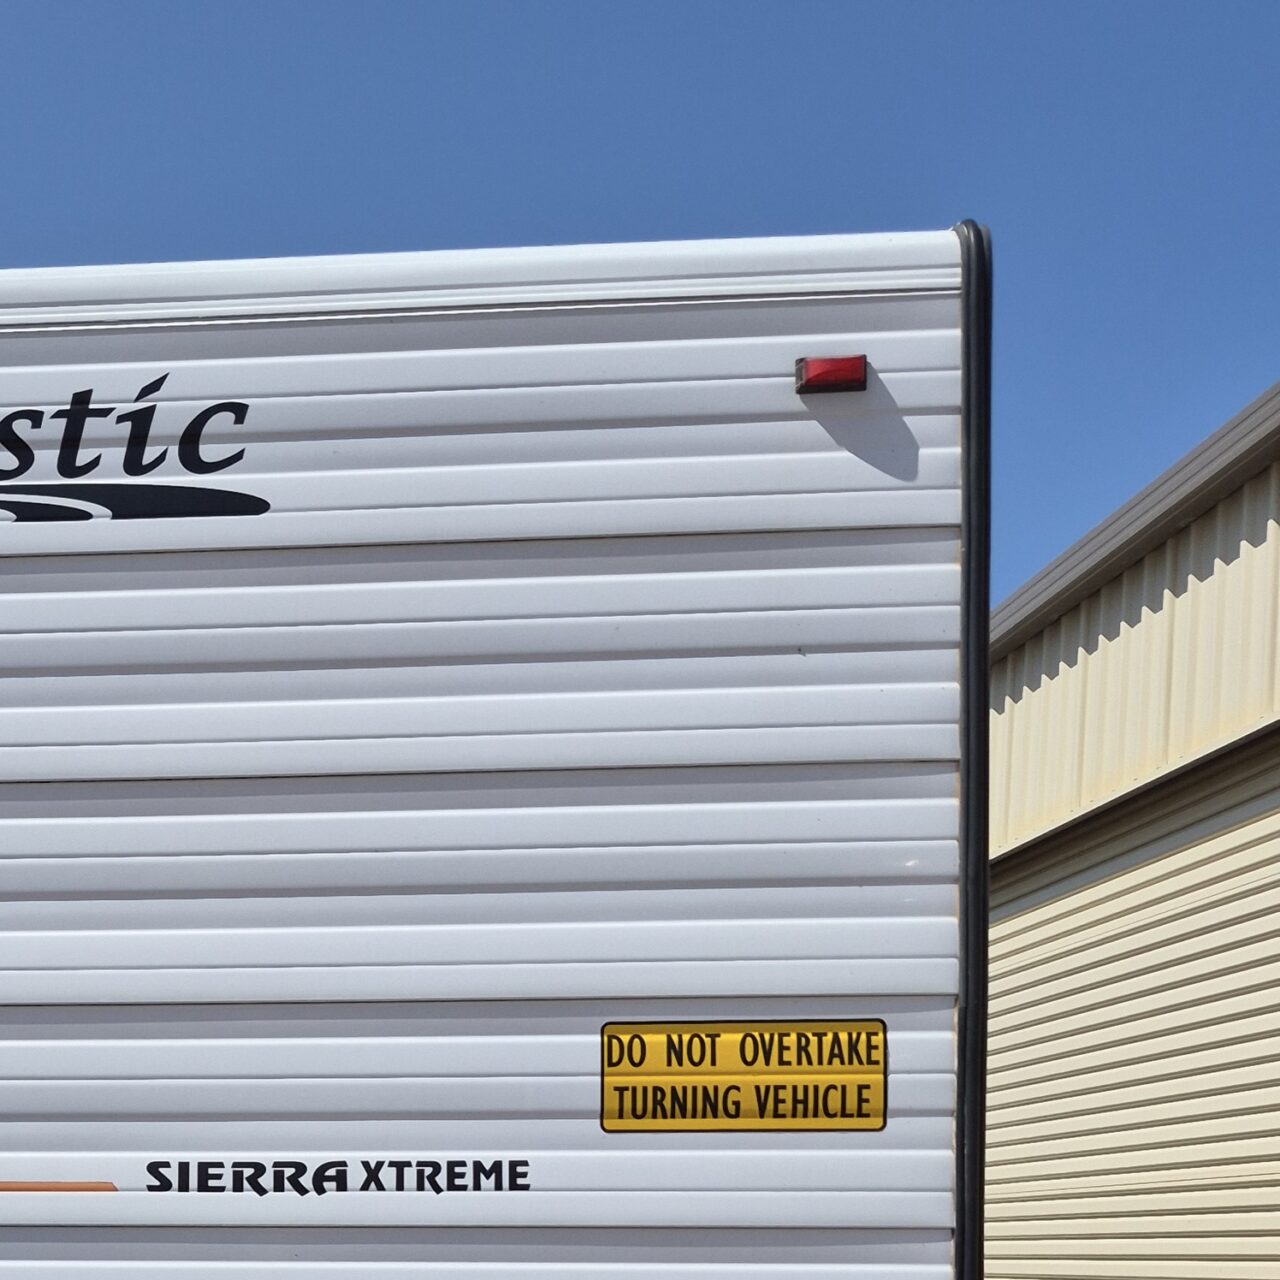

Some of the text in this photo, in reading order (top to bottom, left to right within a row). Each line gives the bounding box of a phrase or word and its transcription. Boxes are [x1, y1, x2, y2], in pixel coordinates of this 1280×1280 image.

[606, 1031, 881, 1068] DO NOT OVERTAKE
[613, 1084, 872, 1120] TURNING VEHICLE
[146, 1159, 532, 1197] SIERRA XTREME
